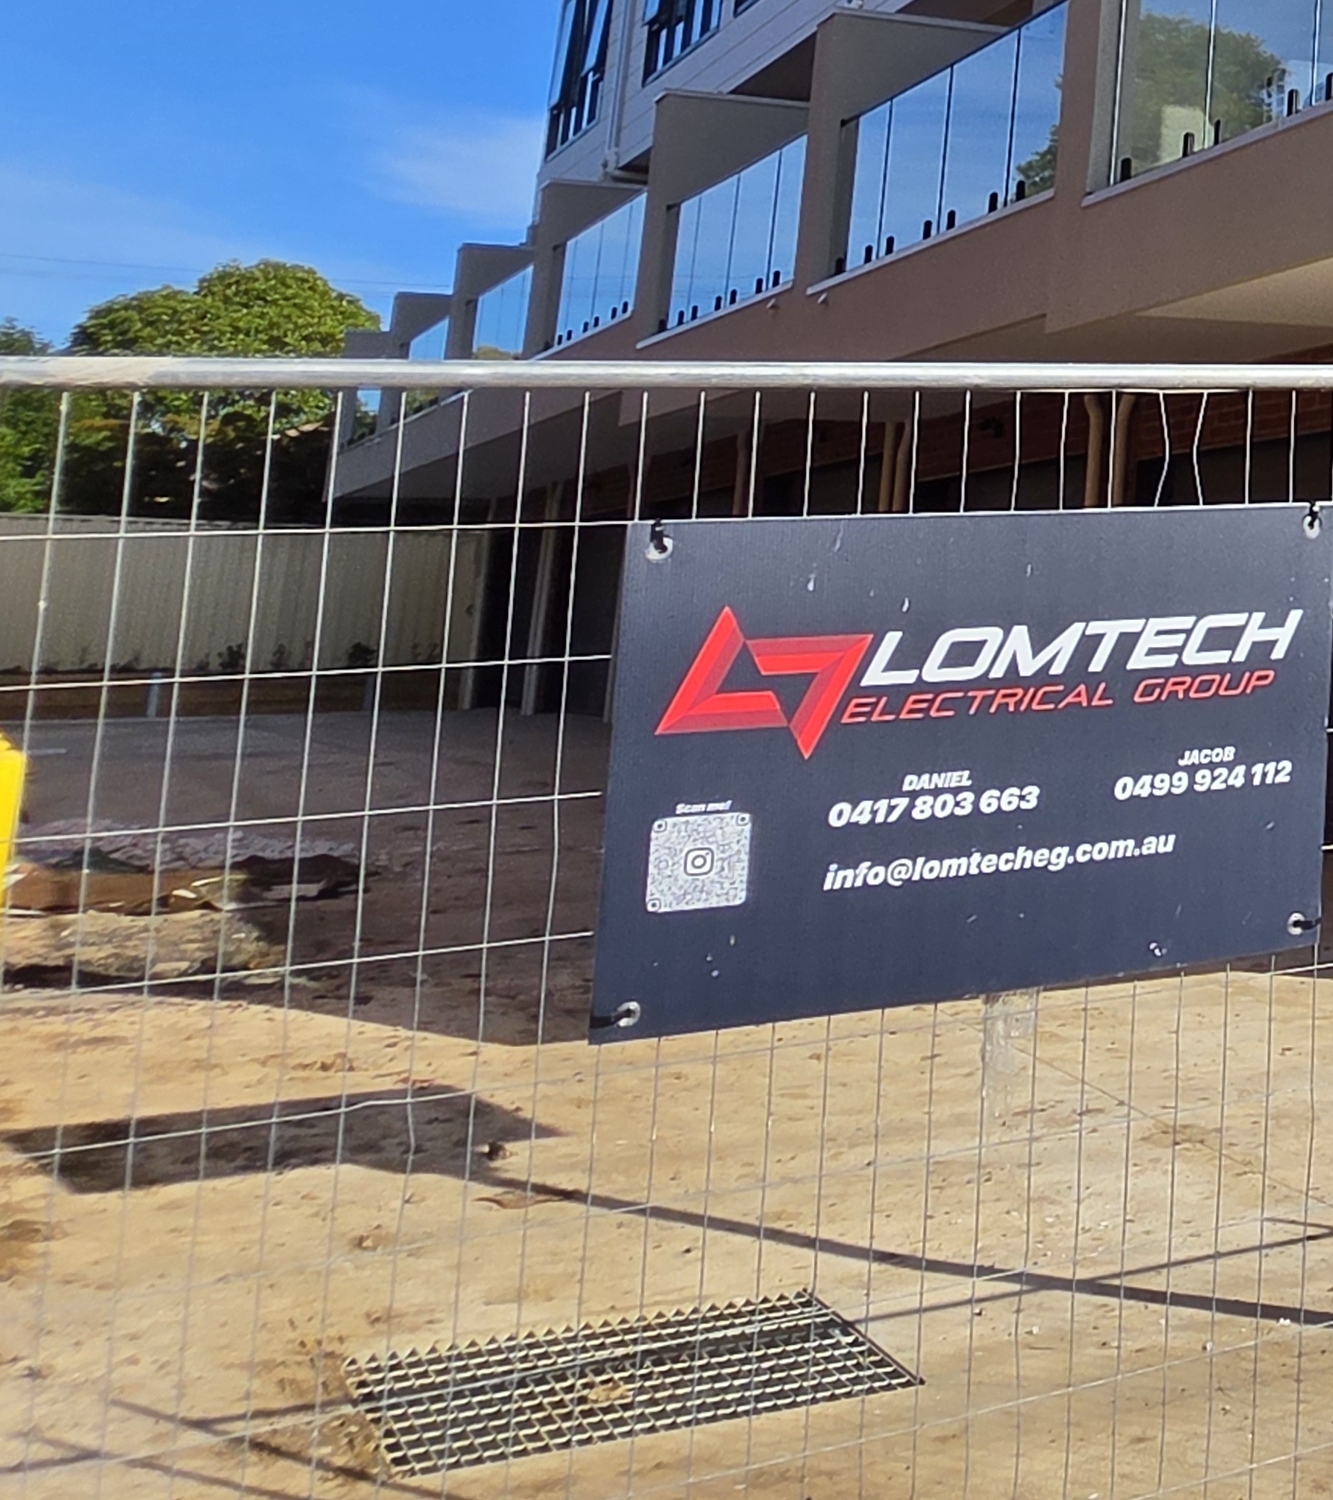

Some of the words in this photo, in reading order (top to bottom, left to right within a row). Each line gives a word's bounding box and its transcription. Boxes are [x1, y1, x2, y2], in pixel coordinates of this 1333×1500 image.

[860, 609, 1303, 687] LOMTECH
[840, 682, 1113, 724] ELECTRICAL
[1133, 669, 1276, 703] GROUP
[1177, 746, 1236, 767] JACOB
[902, 770, 972, 791] DANIEL
[1114, 771, 1189, 800] 0499
[1193, 765, 1246, 793] 924
[1251, 760, 1293, 786] 112
[675, 803, 706, 814] Scan
[706, 800, 732, 812] me!
[828, 798, 909, 828] 0417
[911, 791, 975, 820] 803
[979, 785, 1040, 814] 663
[823, 834, 1176, 891] info@lomtecheg.com.au
